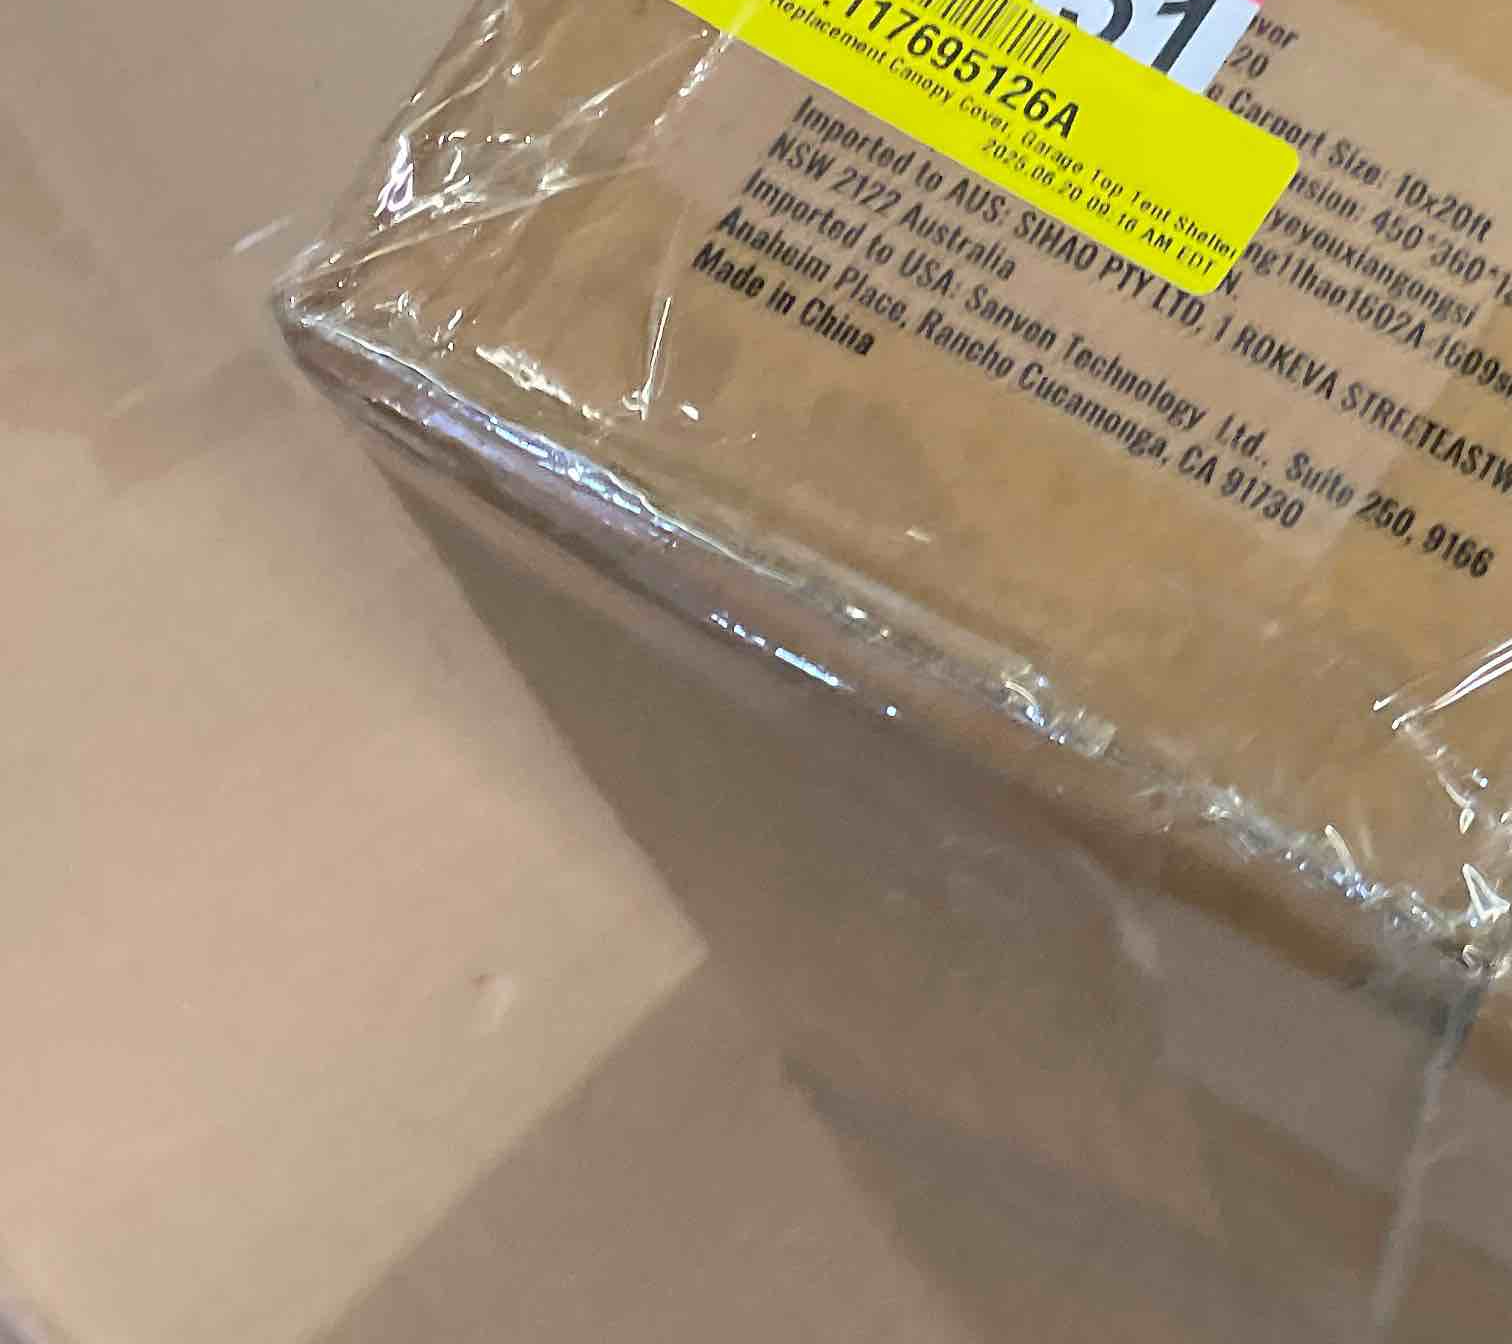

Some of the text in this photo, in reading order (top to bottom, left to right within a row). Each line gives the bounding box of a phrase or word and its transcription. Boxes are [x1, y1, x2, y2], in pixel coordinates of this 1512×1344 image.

[767, 132, 1016, 281] NSW 2122 Australia
[888, 57, 952, 104] Canopy
[1021, 132, 1084, 174] Garage
[1091, 168, 1124, 198] Top
[1131, 190, 1172, 223] Tent
[1173, 215, 1236, 258] Shelter
[1327, 139, 1382, 188] Size:
[1395, 173, 1493, 243] 10x20ft
[691, 241, 875, 357] Made in China
[792, 94, 917, 175] Imported
[915, 159, 944, 191] to
[945, 177, 1010, 228] AUS:
[1013, 210, 1099, 271] SIHAO
[1098, 253, 1155, 298] PTY
[1231, 325, 1339, 401] ROKEVA
[1141, 227, 1173, 252] AM
[1176, 246, 1214, 274] EDT
[714, 206, 1305, 529] Anaheim Place, Rancho Cucamonga, CA 91730
[742, 167, 867, 249] Imported
[865, 233, 894, 264] to
[899, 249, 955, 302] USA:
[964, 284, 1057, 351] Sanven
[1063, 334, 1207, 430] Technology
[1285, 451, 1355, 506] Suite
[1422, 524, 1495, 578] 9166
